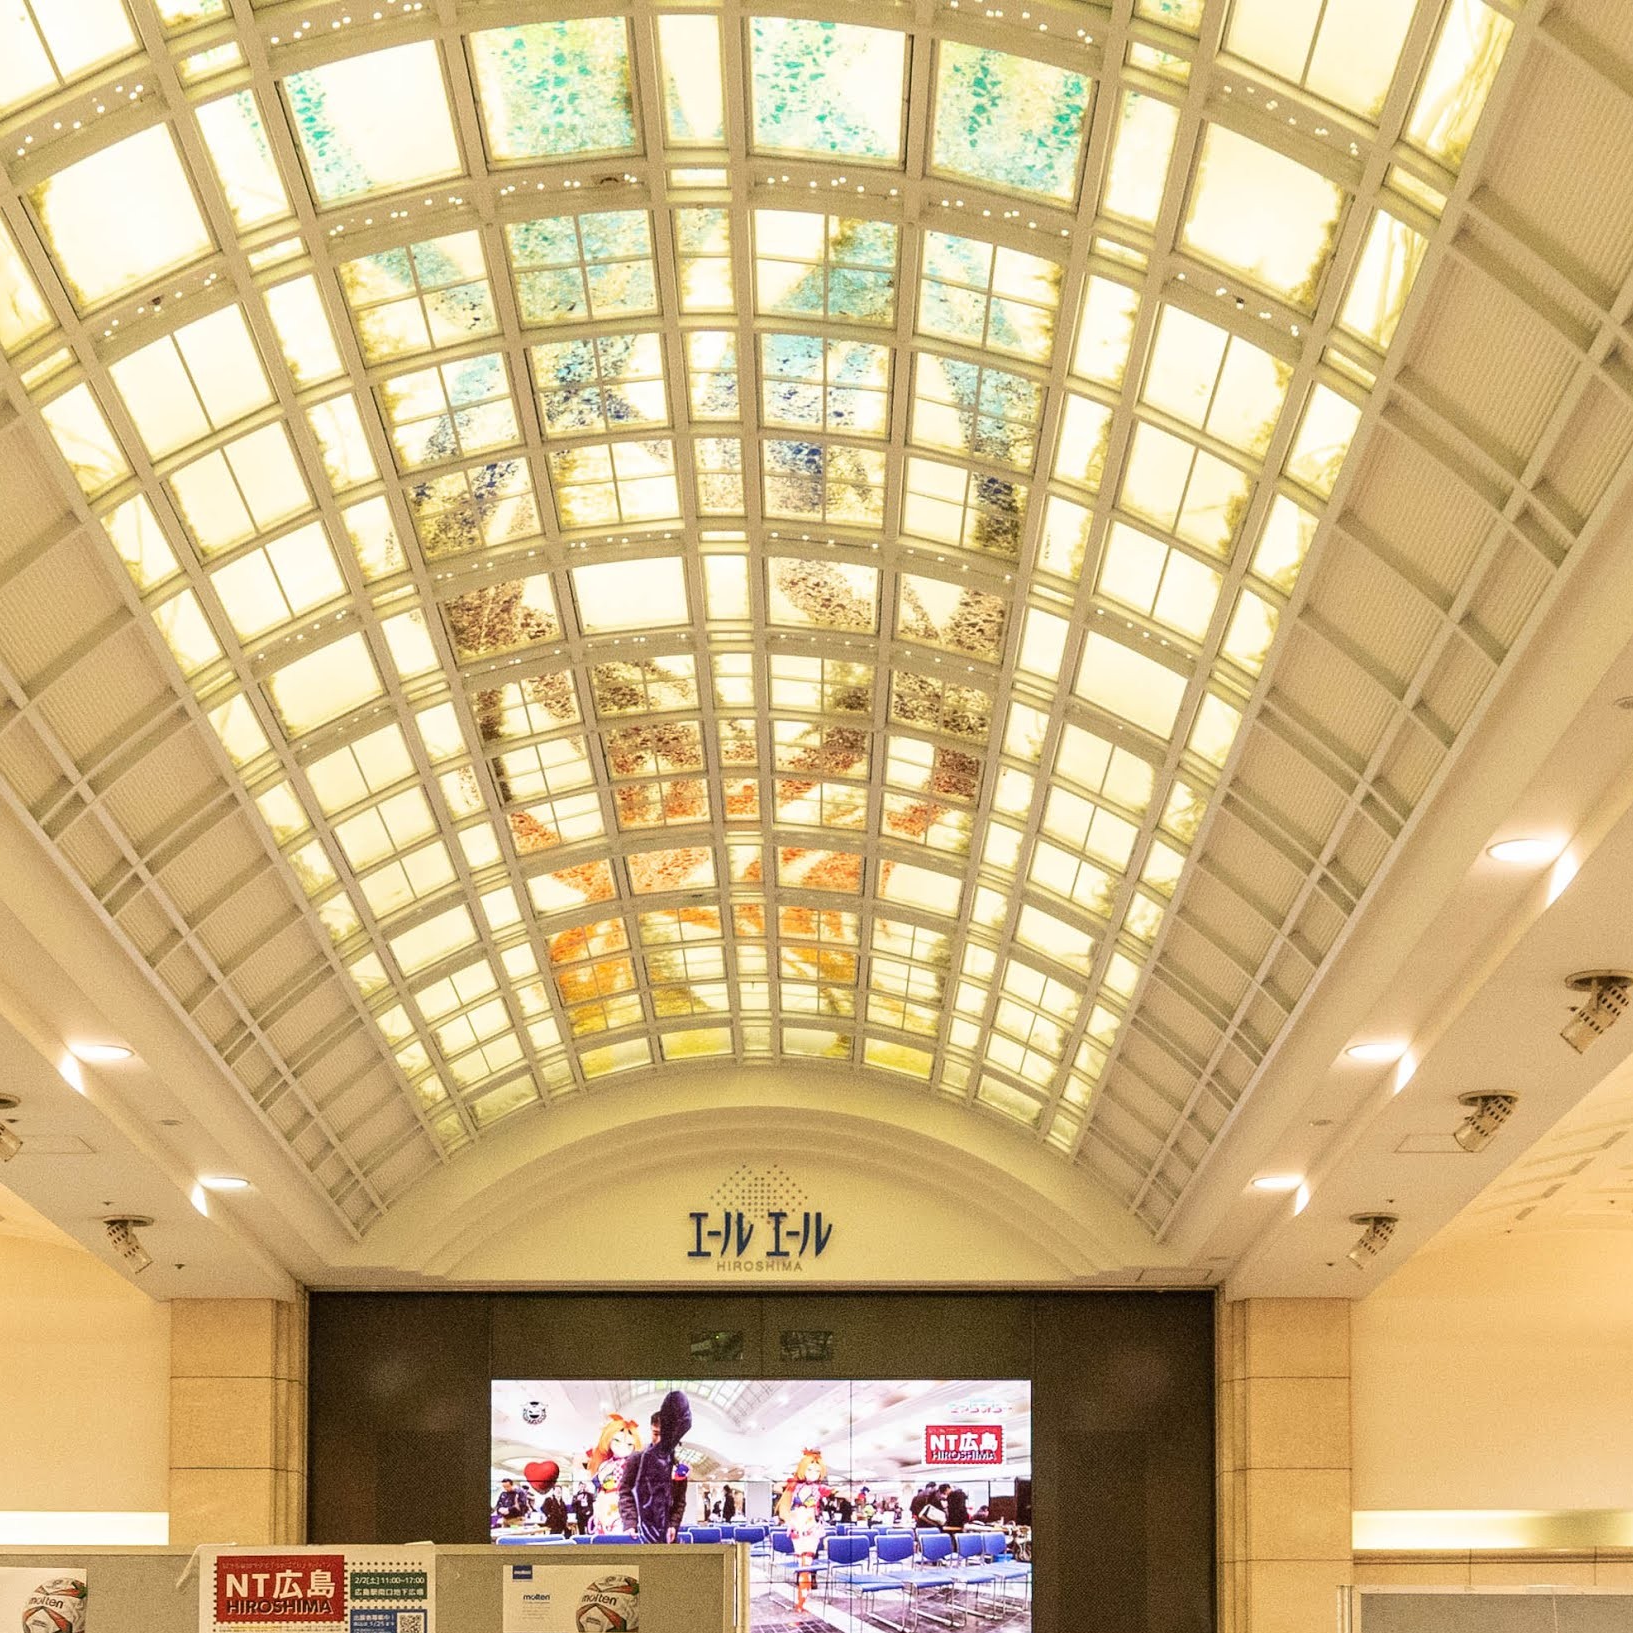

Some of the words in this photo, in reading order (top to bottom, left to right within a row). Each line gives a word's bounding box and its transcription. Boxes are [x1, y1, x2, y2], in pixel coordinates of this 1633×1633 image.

[717, 1261, 803, 1272] HIROSHIMA
[930, 1432, 999, 1451] NT広島
[932, 1450, 997, 1461] HIROSHIMA
[226, 1569, 336, 1599] NT広島
[29, 1597, 64, 1609] molten
[582, 1594, 617, 1606] molten
[227, 1600, 334, 1616] HIROSHIMA
